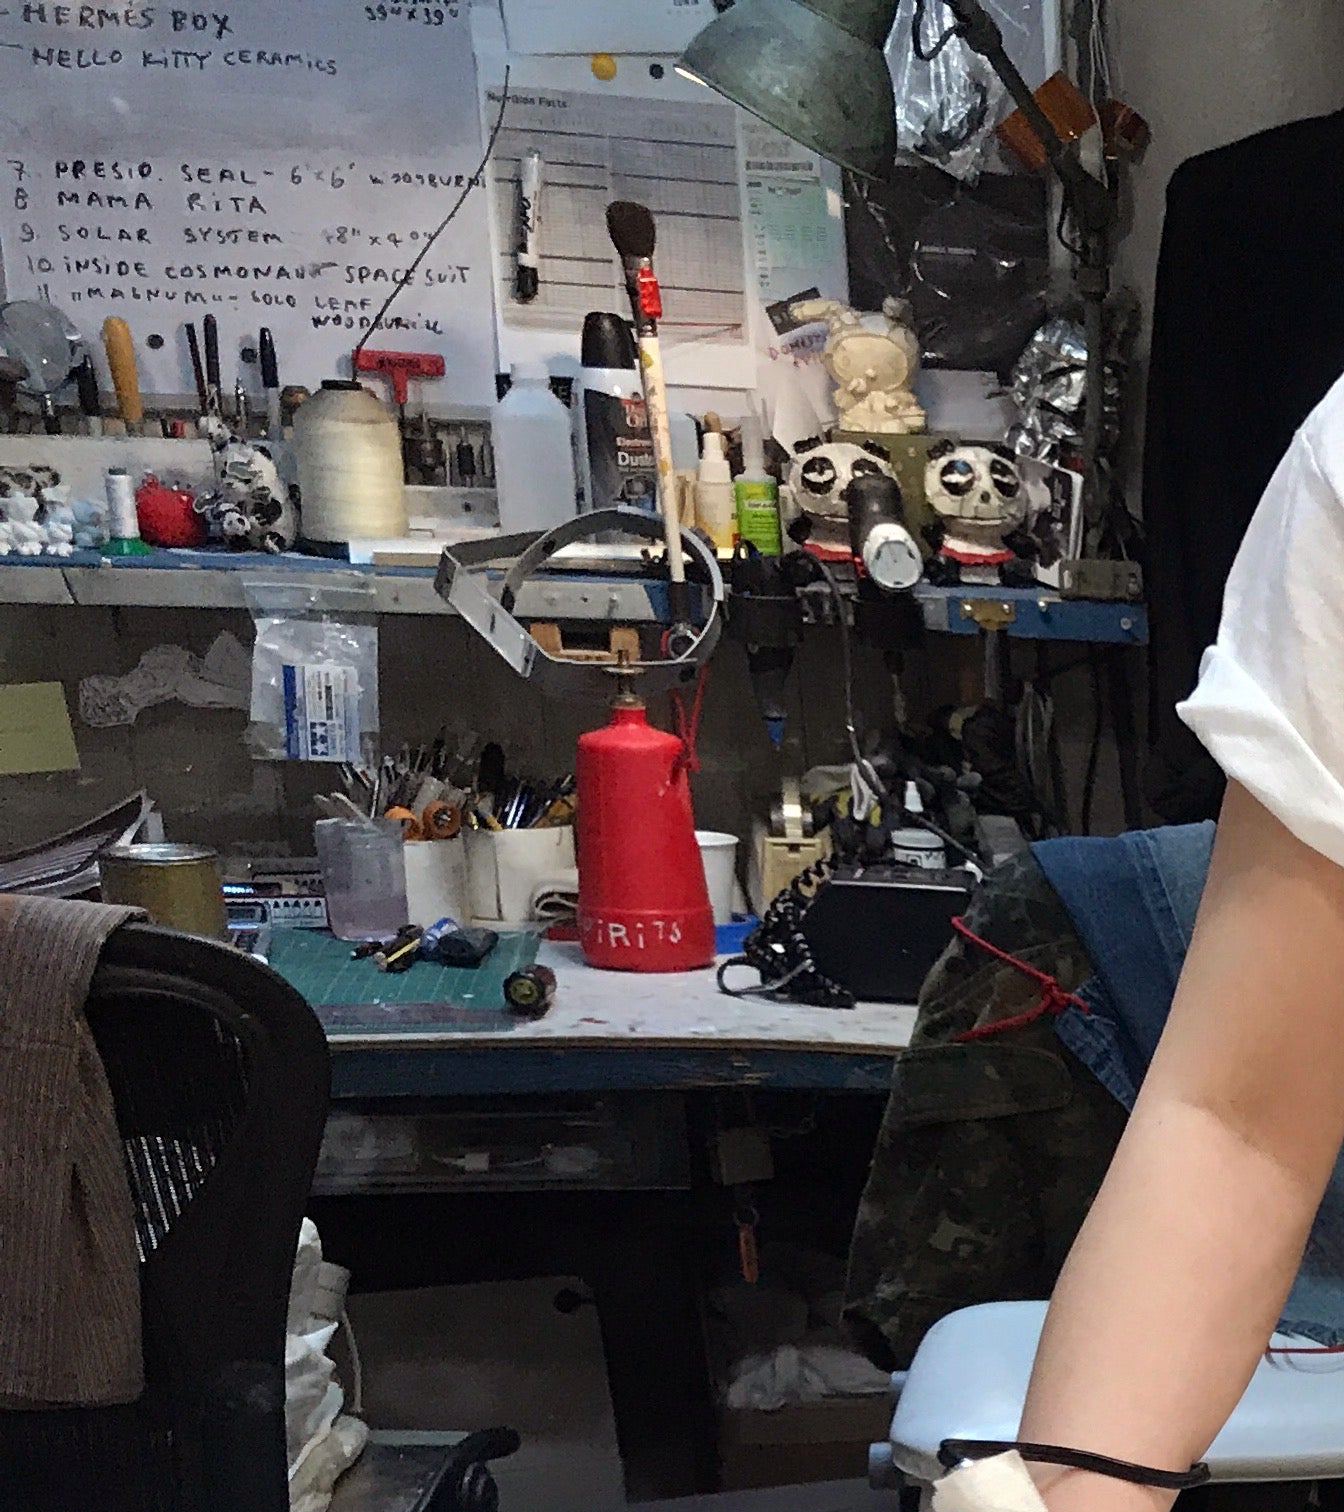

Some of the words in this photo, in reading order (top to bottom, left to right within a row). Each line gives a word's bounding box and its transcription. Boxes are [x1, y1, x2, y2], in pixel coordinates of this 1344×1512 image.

[171, 9, 234, 39] BOX
[32, 48, 123, 69] HELLO
[181, 164, 257, 184] SEAL
[58, 191, 152, 210] MAMA
[58, 224, 152, 244] SOLAR
[184, 226, 283, 245] SYSTEM
[314, 295, 372, 313] LEAF
